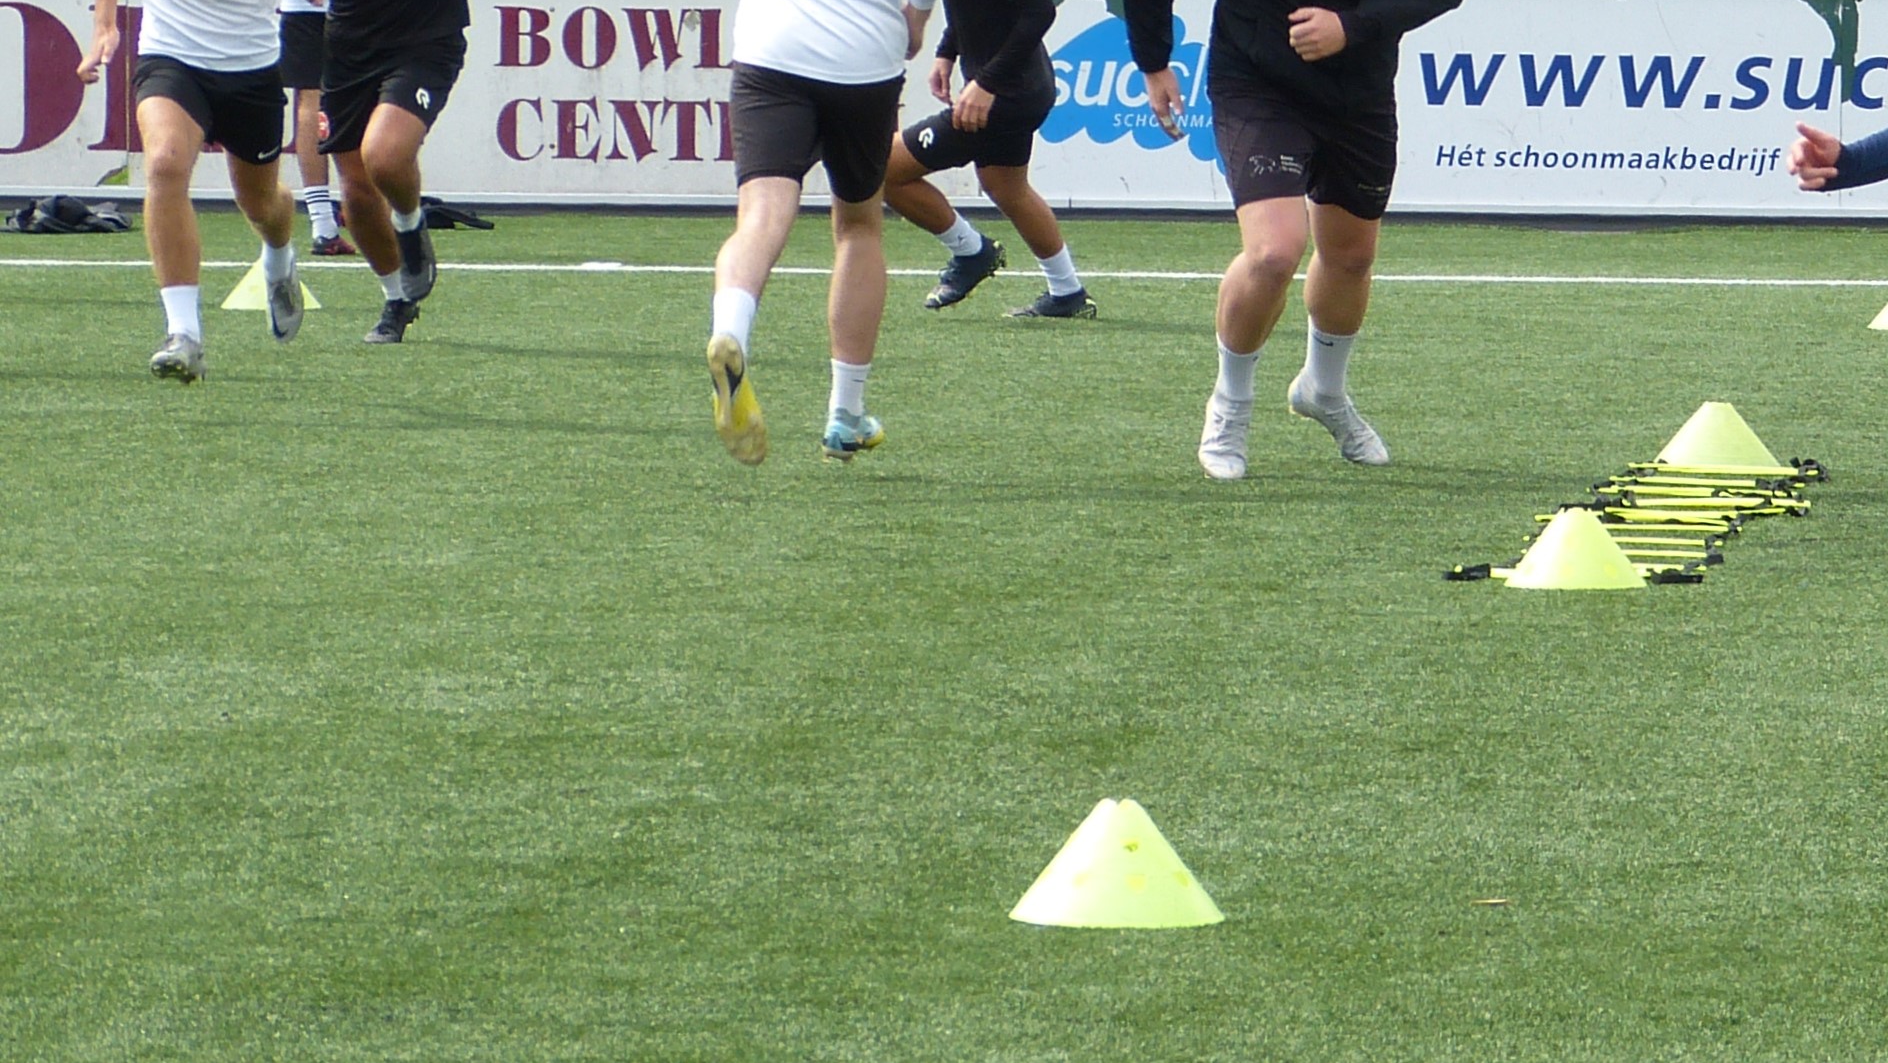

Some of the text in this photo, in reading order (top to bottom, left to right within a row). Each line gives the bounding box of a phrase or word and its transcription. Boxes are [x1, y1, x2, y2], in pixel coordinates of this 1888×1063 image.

[493, 6, 734, 71] BOWL
[1436, 144, 1487, 167] Hét
[1494, 146, 1781, 176] schoonmaakbedrijf
